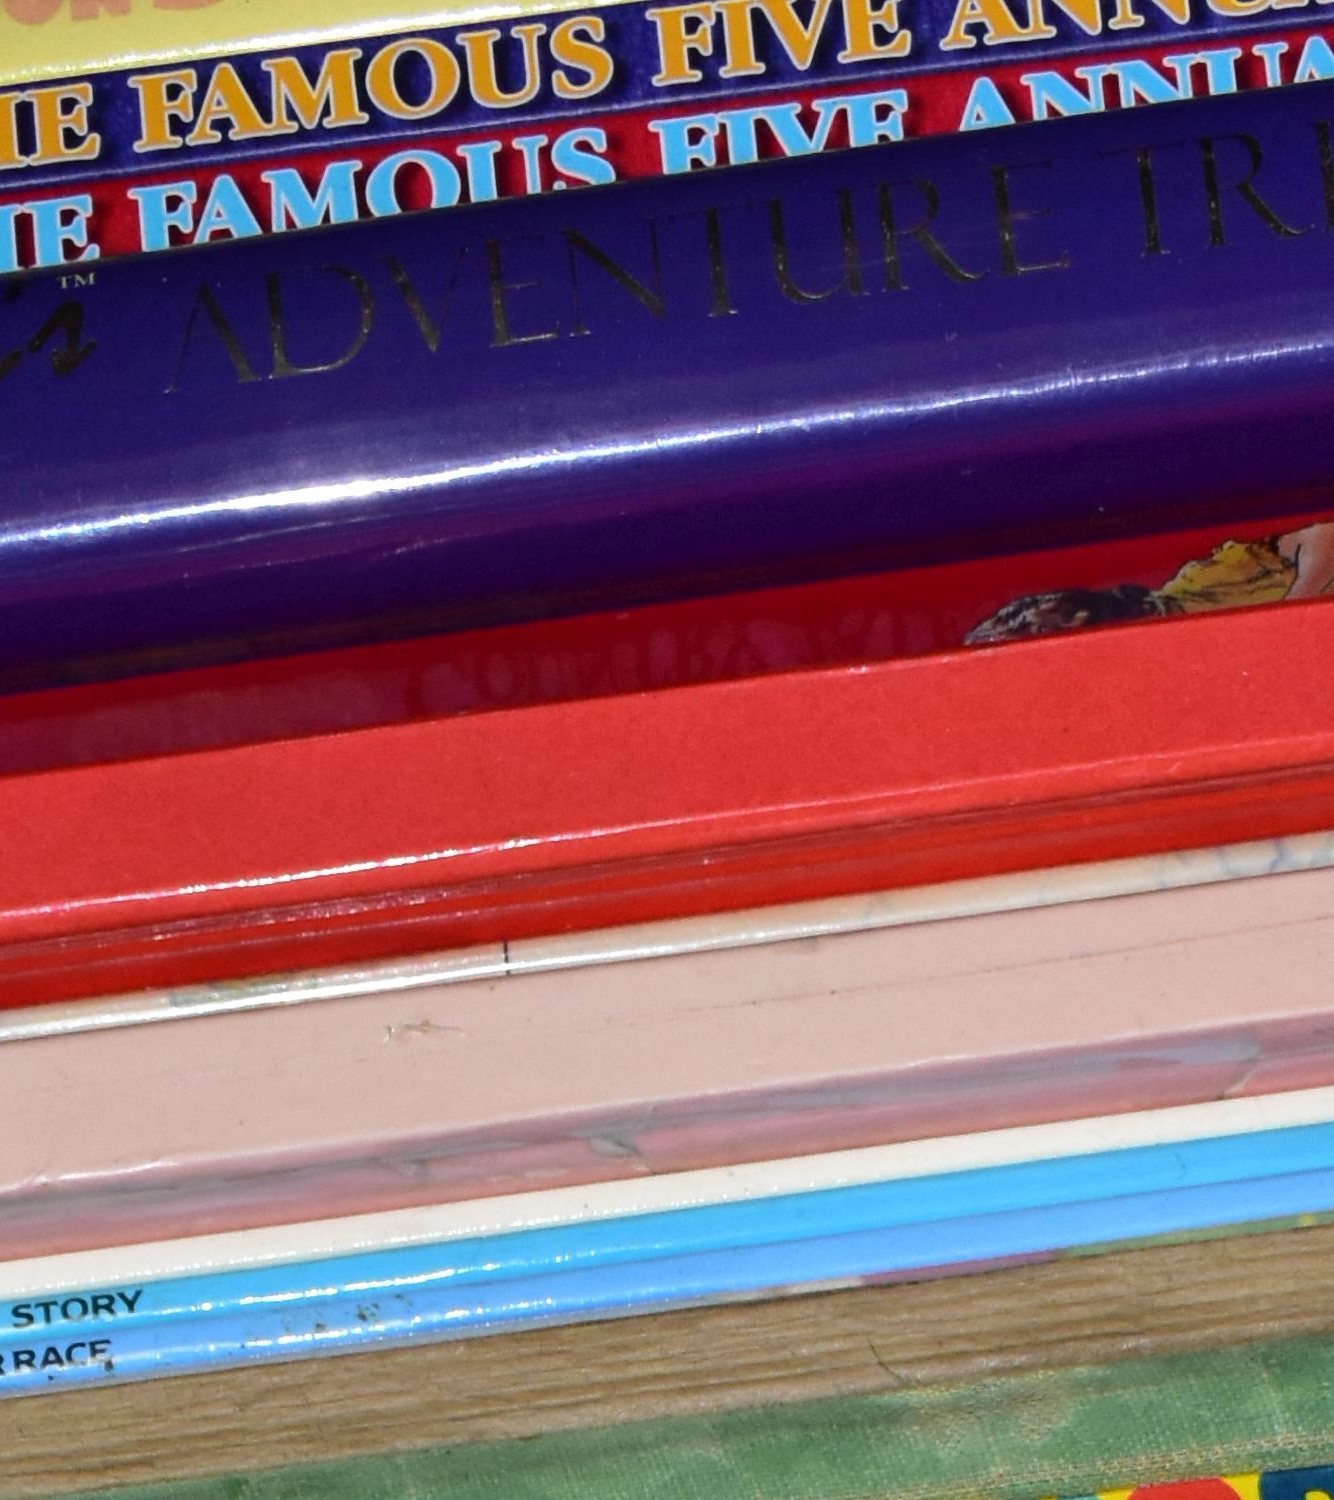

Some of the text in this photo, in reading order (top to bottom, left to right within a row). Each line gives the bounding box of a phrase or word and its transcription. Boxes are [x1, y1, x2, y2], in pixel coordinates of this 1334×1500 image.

[128, 16, 614, 153] FAMOUS
[649, 0, 911, 88] FIVE
[128, 127, 617, 252] FAMOUS
[649, 89, 908, 174] FIVE
[166, 160, 1067, 394] ADVENTURE
[12, 1289, 144, 1329] STORY
[14, 1339, 112, 1369] RACE
